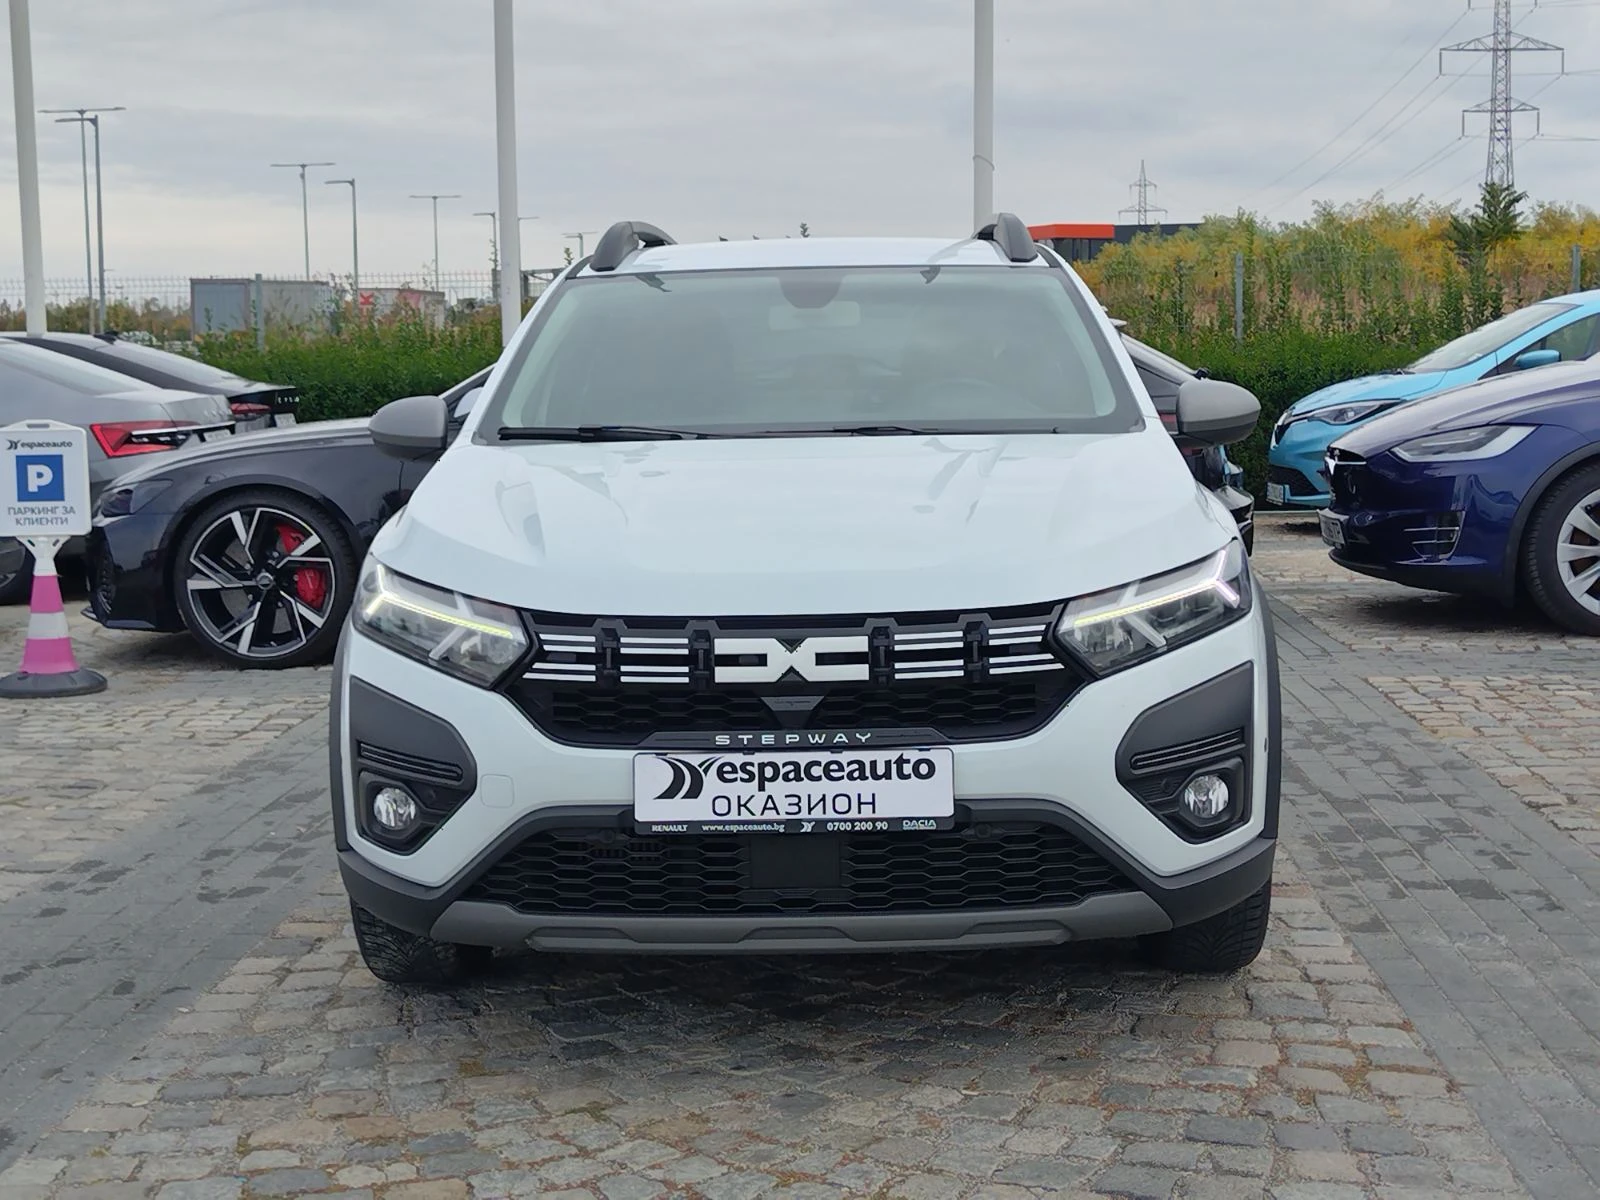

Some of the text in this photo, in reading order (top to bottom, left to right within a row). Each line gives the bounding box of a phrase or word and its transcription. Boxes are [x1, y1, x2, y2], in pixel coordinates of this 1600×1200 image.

[20, 440, 73, 450] espaceauto
[27, 464, 54, 493] P
[8, 506, 76, 516] ПАРКИНГ ЗА
[15, 516, 69, 526] КЛИЕНТИ
[715, 732, 872, 746] STEPWAY
[716, 753, 936, 793] espaceauto
[711, 793, 877, 817] ОКАЗИОН
[651, 819, 937, 833] RENAULT www.espaceauto.bg 0700 200 90 DACIA
